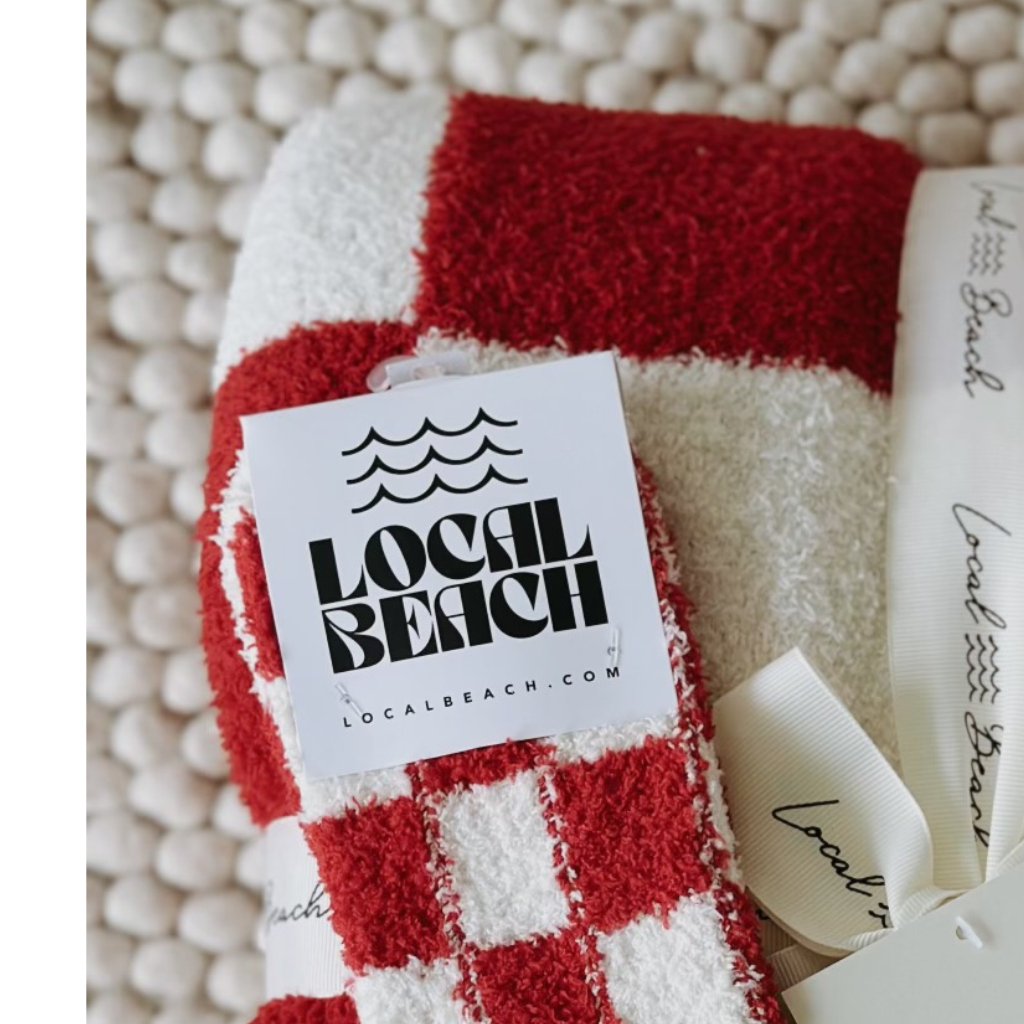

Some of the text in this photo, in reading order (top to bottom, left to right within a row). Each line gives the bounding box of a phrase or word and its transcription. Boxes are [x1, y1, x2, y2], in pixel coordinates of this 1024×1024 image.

[960, 282, 1012, 399] Beach
[308, 497, 594, 605] LOCAL
[952, 503, 1012, 629] Local
[321, 560, 609, 674] BEACH
[343, 666, 620, 728] LOCALBEACH.COM
[771, 799, 885, 897] Local
